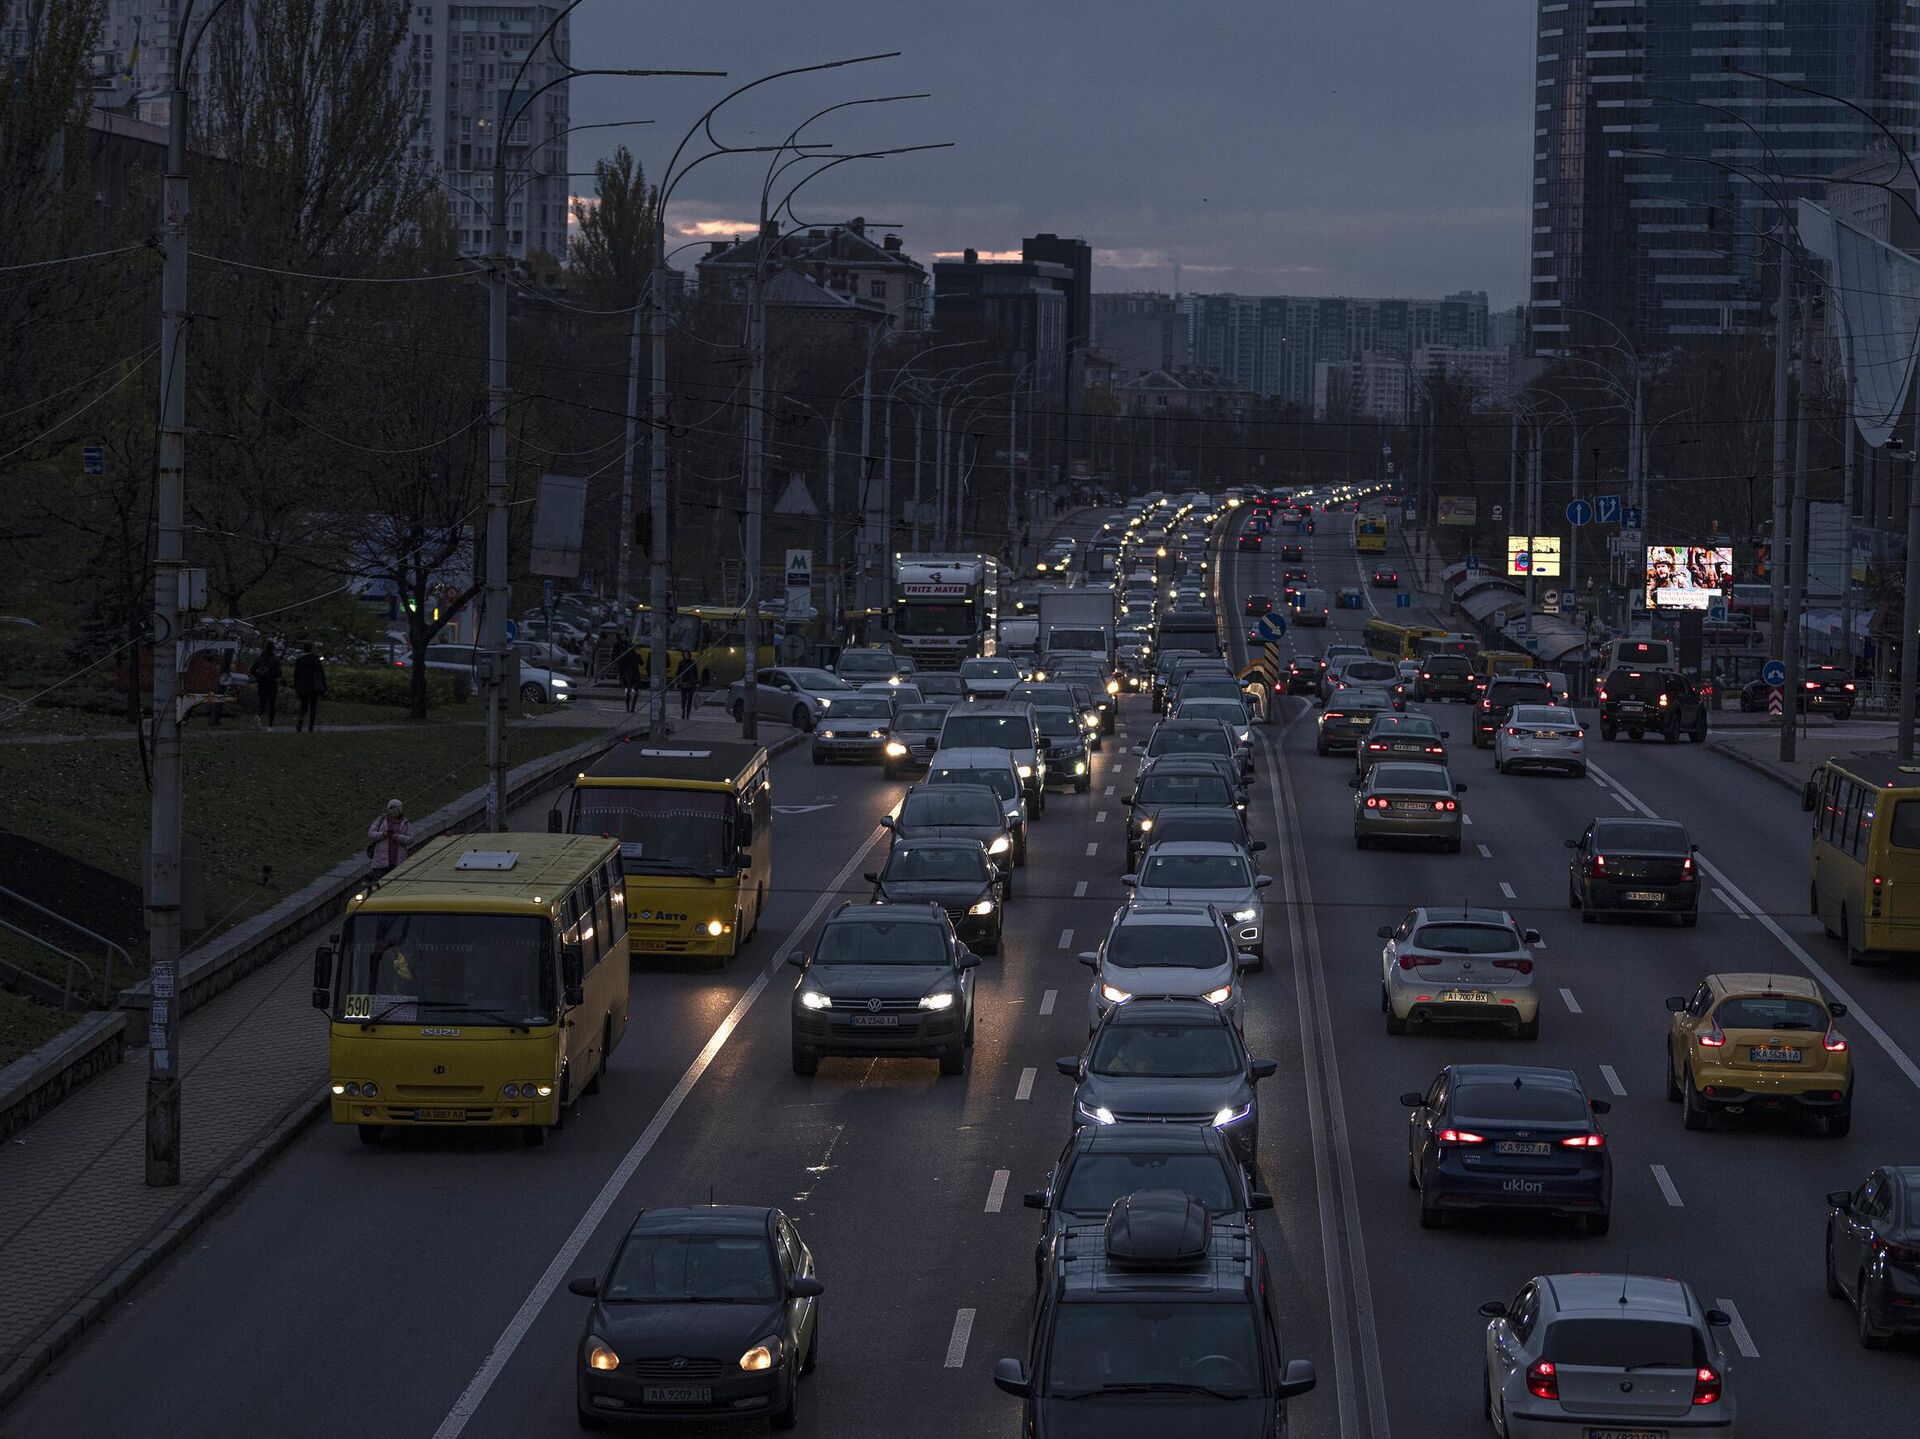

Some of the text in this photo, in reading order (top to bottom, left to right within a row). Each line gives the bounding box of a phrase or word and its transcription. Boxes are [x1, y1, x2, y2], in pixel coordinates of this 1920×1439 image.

[906, 585, 964, 595] FRITZ MAYER
[1459, 993, 1474, 1001] 7007
[347, 996, 369, 1017] 590
[856, 1017, 866, 1025] KA
[421, 1028, 461, 1037] ISUZU
[1757, 1050, 1768, 1058] KA
[1501, 1143, 1549, 1153] KA 9257 IA
[1503, 1178, 1543, 1193] uklon
[651, 1389, 666, 1400] AA
[669, 1389, 692, 1400] 9209
